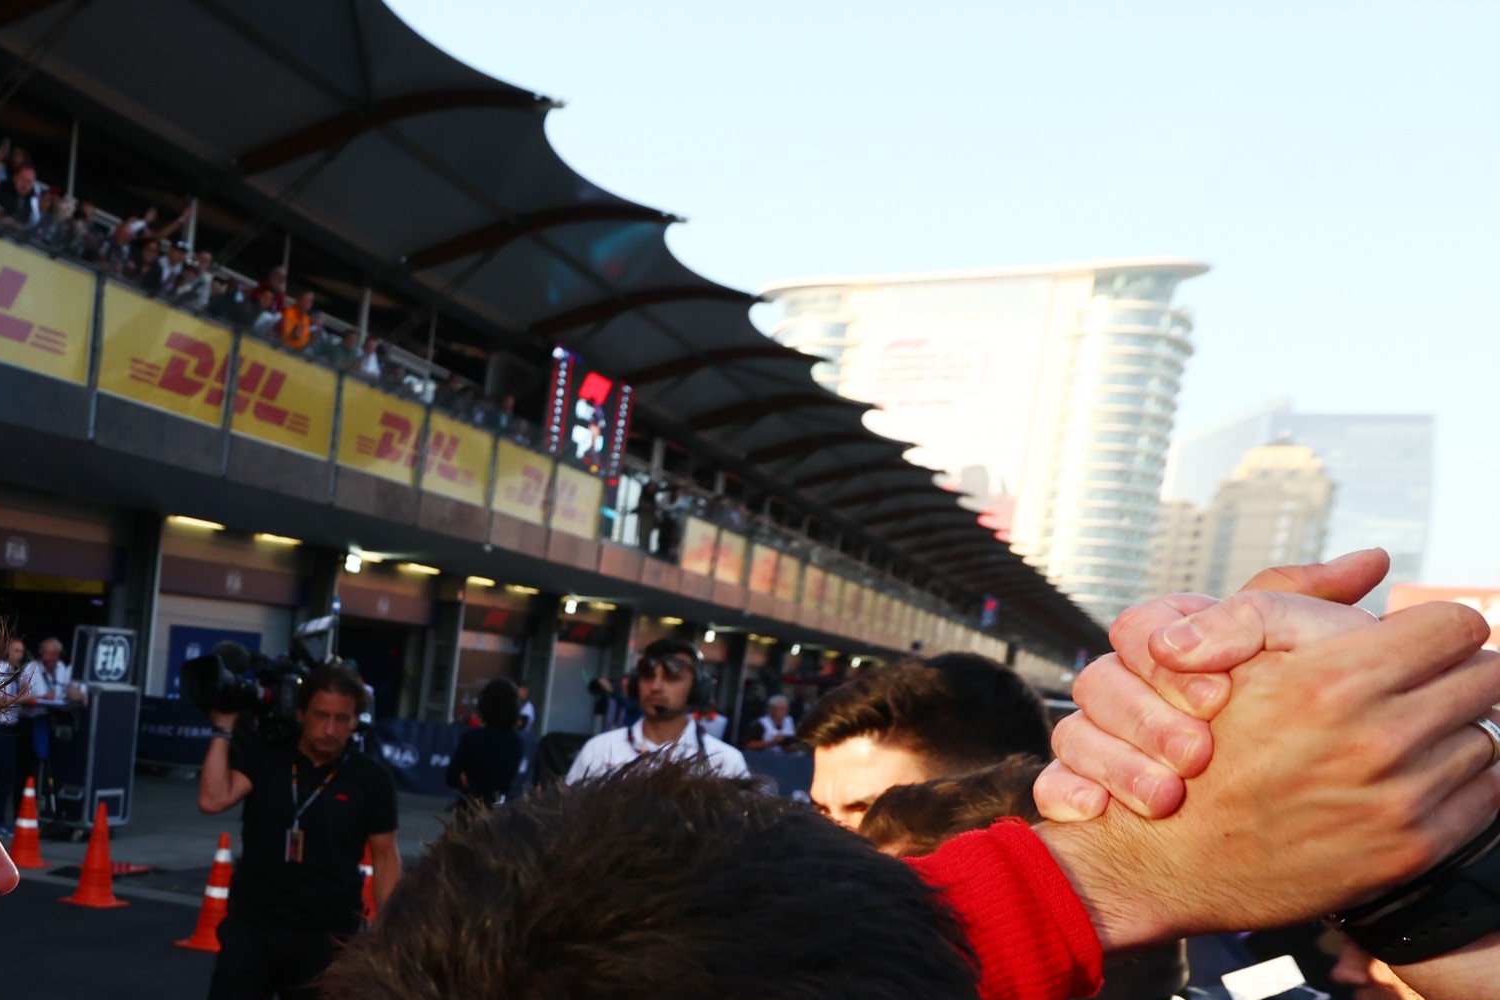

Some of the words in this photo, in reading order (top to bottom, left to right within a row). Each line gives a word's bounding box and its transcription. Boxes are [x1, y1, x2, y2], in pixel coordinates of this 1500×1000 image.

[158, 331, 288, 427] DHL
[375, 411, 458, 481] DHL
[96, 643, 127, 673] FIA
[176, 726, 214, 738] FERM
